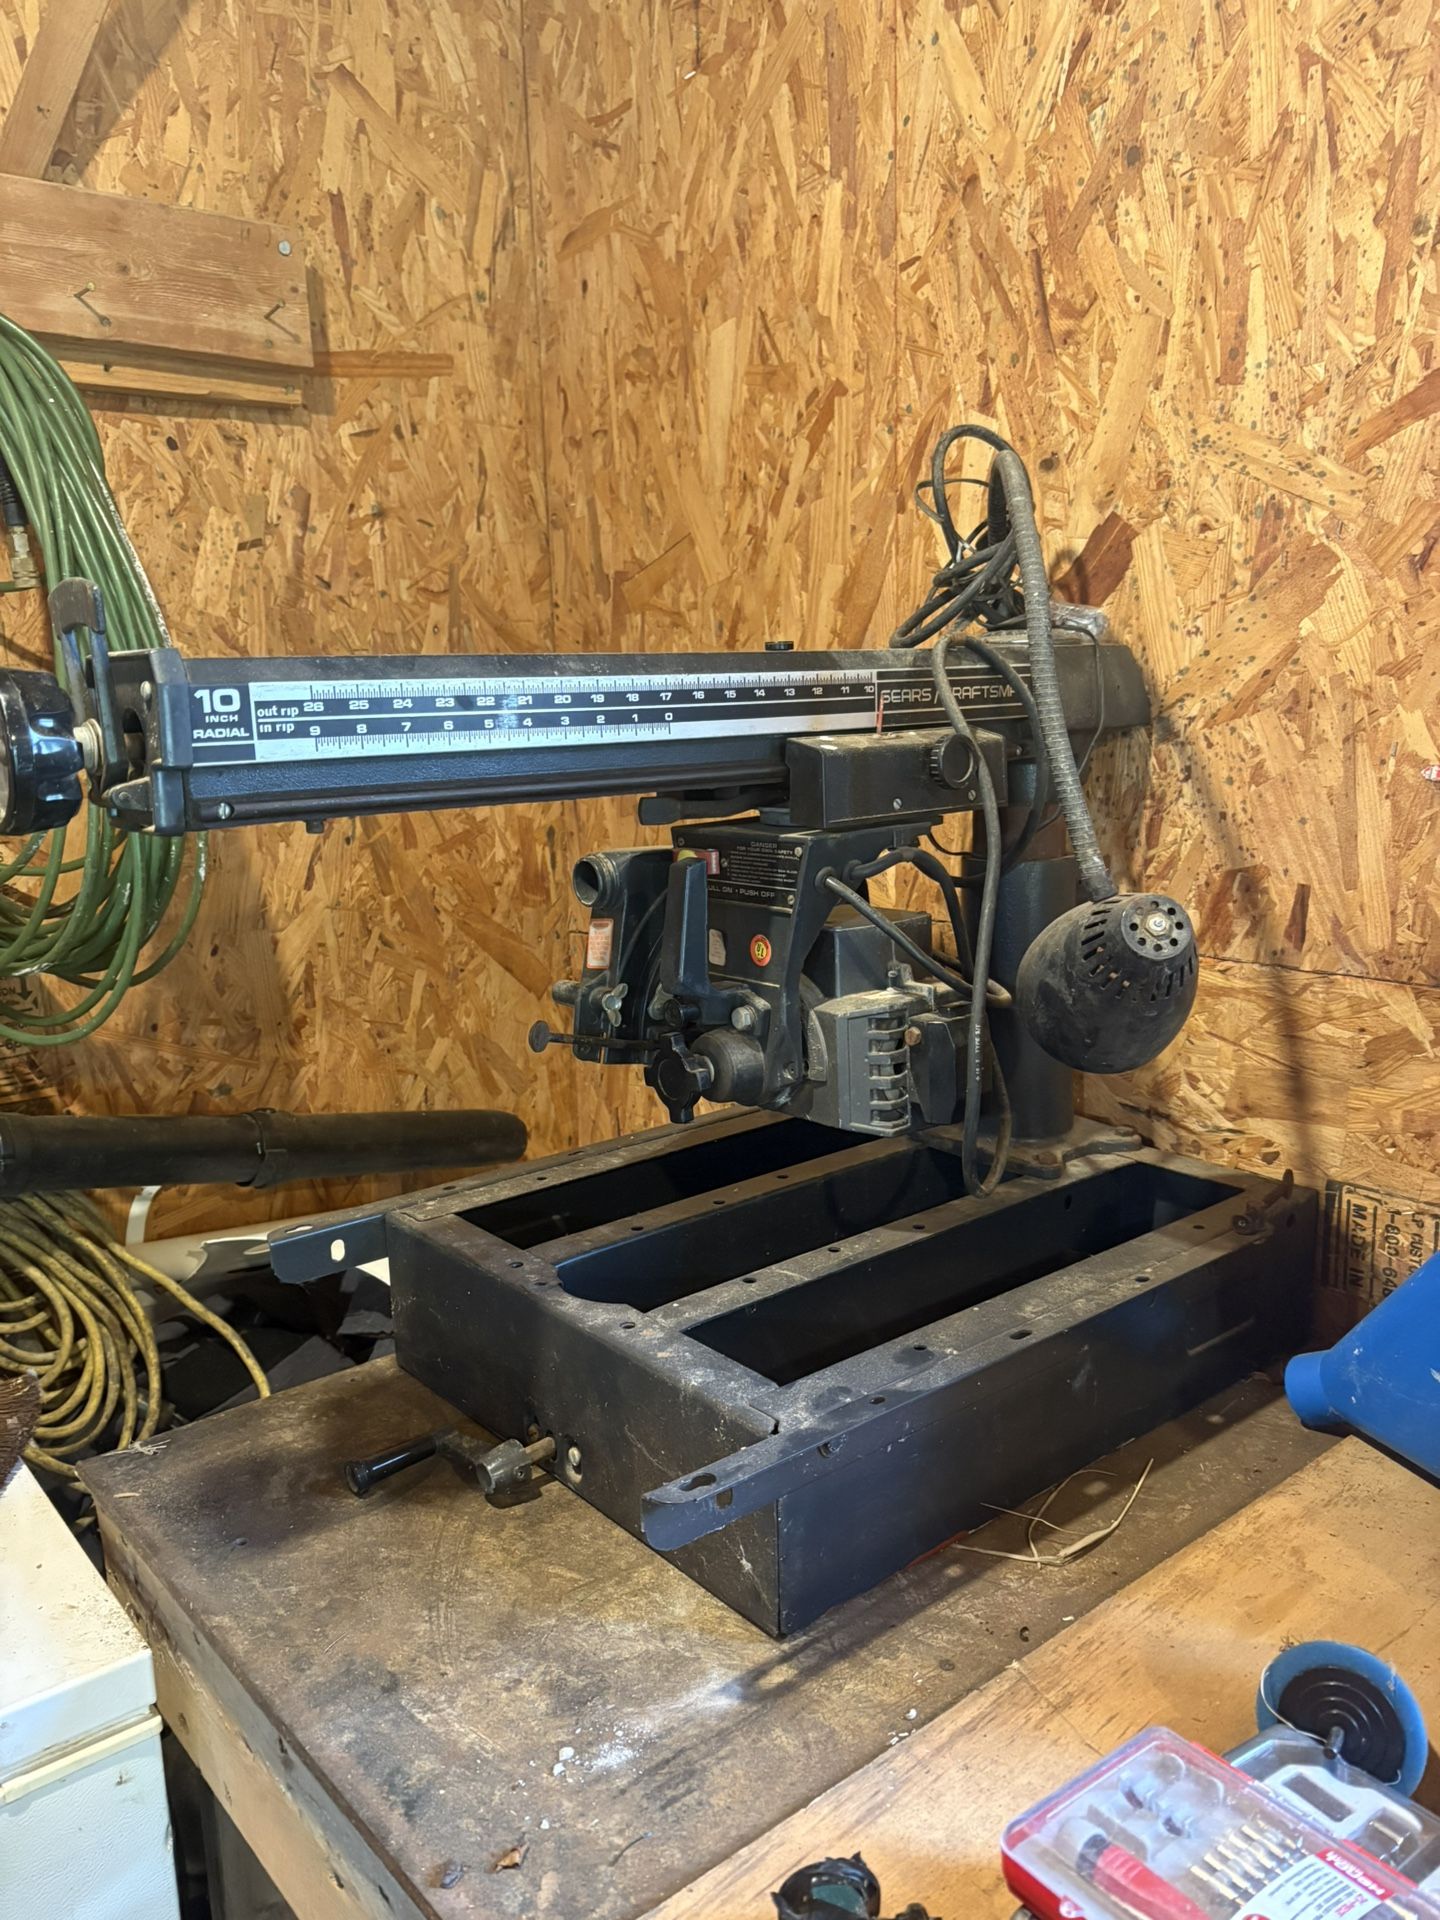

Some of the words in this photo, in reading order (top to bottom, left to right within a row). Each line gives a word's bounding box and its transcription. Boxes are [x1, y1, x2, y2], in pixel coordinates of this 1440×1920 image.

[194, 688, 241, 713] 10
[257, 705, 278, 717] out
[280, 706, 299, 718] rip
[303, 702, 324, 712] 26
[349, 700, 369, 710] 25
[393, 698, 413, 709] 24
[435, 697, 455, 708] 23
[476, 696, 495, 706] 22
[517, 695, 533, 705] 21
[554, 694, 572, 704] 20
[590, 694, 605, 703] 19
[625, 693, 640, 702] 18
[659, 692, 672, 701] 17
[692, 690, 705, 700] 16
[723, 689, 737, 699] 15
[753, 688, 766, 697] 14
[783, 687, 796, 696] 13
[811, 686, 823, 695] 12
[840, 685, 850, 694] 11
[863, 685, 875, 693] 10
[881, 688, 932, 704] SEARS
[946, 684, 1028, 699] RAFTSM
[205, 714, 239, 723] INCH
[259, 723, 272, 733] in
[275, 723, 295, 734] rip
[309, 725, 321, 736] 9
[356, 723, 367, 734] 8
[401, 721, 412, 732] 7
[443, 720, 454, 730] 6
[484, 719, 494, 728] 5
[522, 717, 533, 727] 4
[560, 716, 570, 726] 3
[596, 715, 606, 724] 2
[632, 713, 639, 722] 1
[664, 712, 673, 721] 0
[193, 727, 250, 739] RADIAL
[740, 888, 759, 896] PUSH
[1351, 1203, 1368, 1261] MADE
[1349, 1267, 1364, 1288] IN
